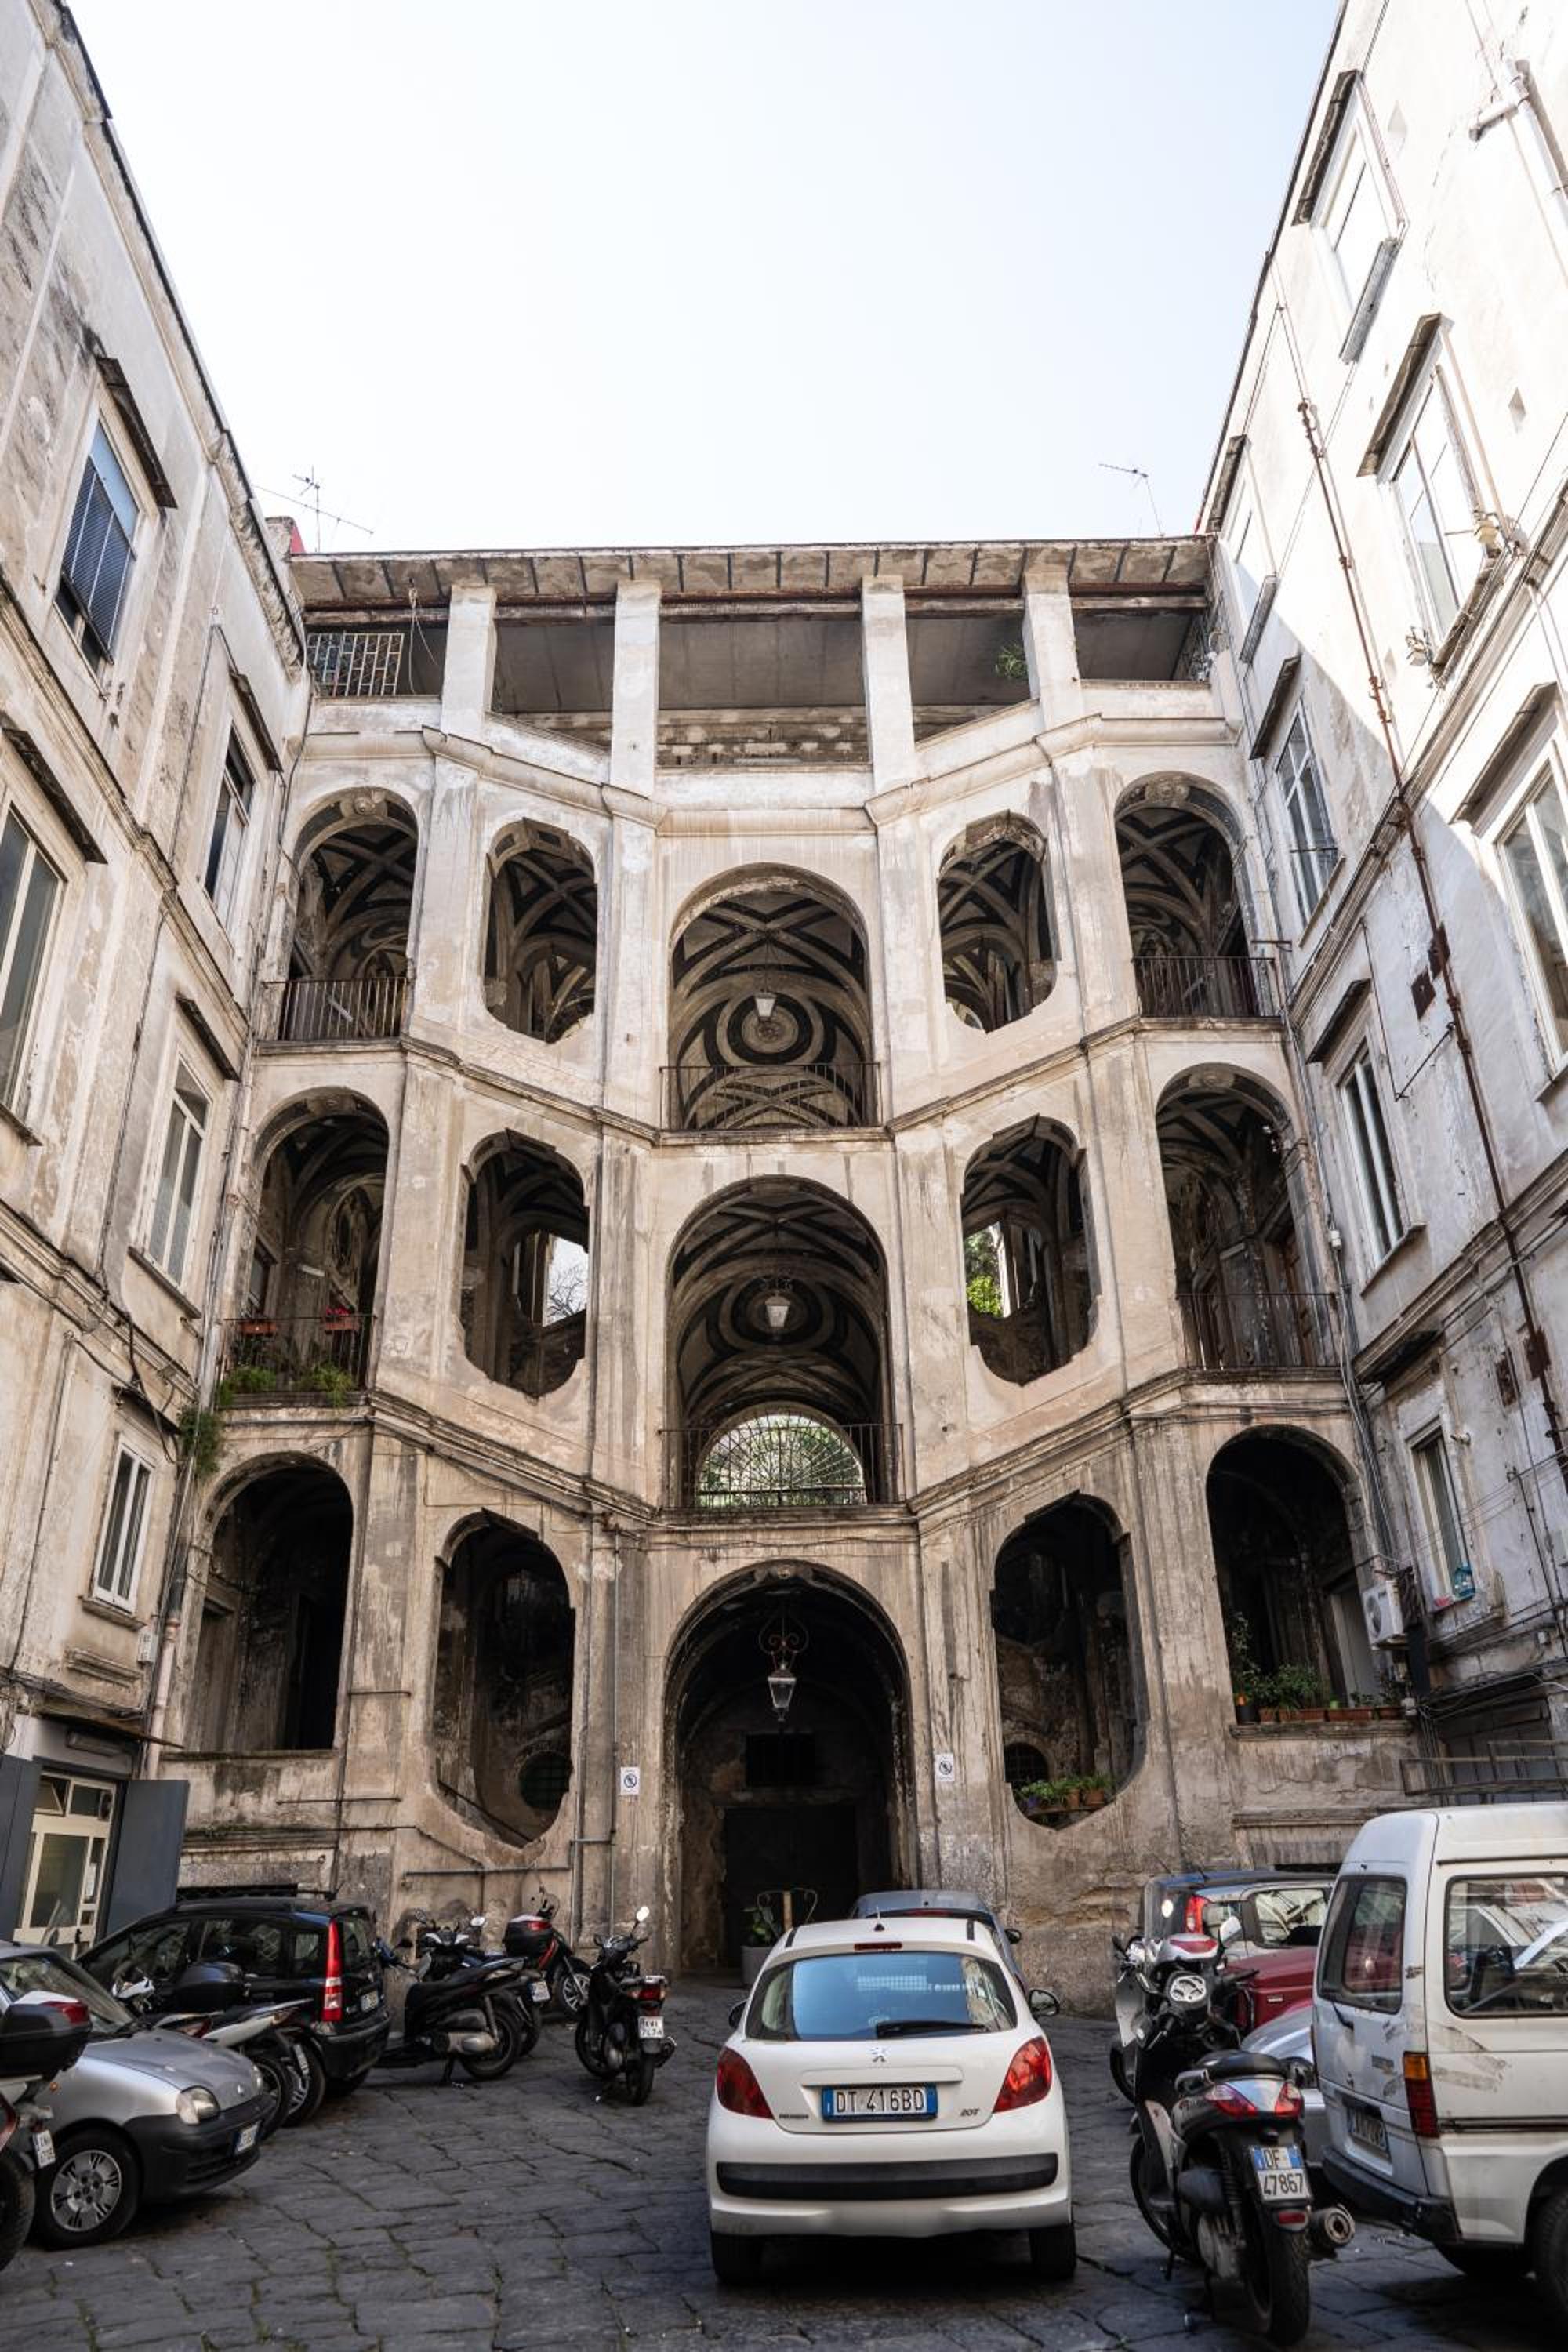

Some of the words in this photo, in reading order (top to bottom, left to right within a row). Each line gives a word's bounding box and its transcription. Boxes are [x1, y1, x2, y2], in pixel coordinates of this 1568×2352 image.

[837, 2091, 857, 2113] DT
[866, 2089, 925, 2112] 416BD
[1263, 2172, 1303, 2196] 47867
